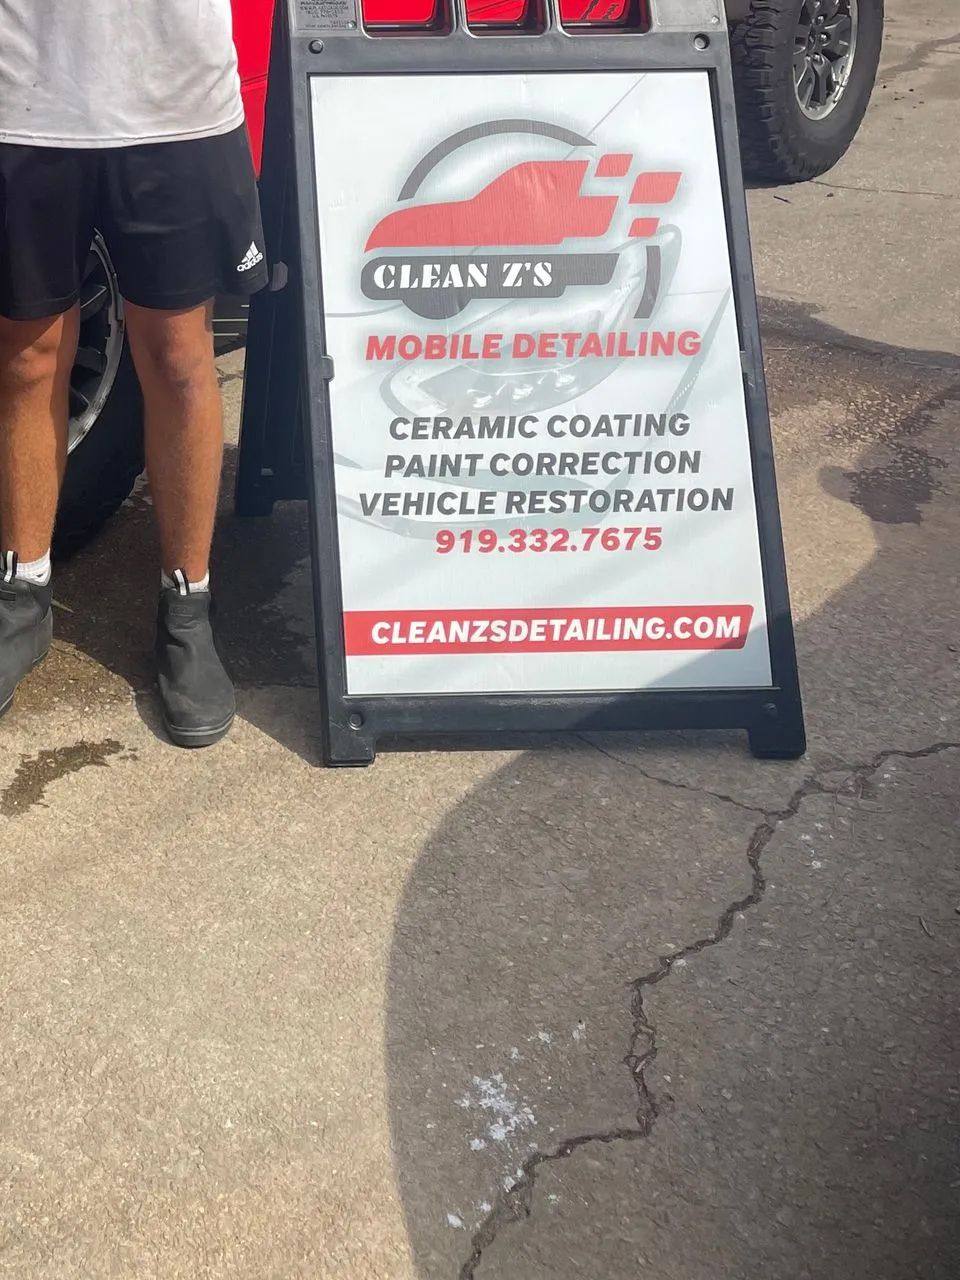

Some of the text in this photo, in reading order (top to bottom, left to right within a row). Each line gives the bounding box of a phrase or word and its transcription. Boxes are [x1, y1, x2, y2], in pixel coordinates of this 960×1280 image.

[236, 251, 263, 272] adidas
[373, 261, 553, 290] CLEAN Z'S
[365, 330, 703, 361] MOBILE DETAILING
[389, 413, 691, 440] CERAMIC COATING
[383, 450, 702, 478] PAINT CORRECTION
[359, 487, 735, 516] VEHICLE RESTORATION
[435, 527, 663, 554] 919.332.7675
[370, 615, 741, 645] CLEANZSDETAILING.COM
